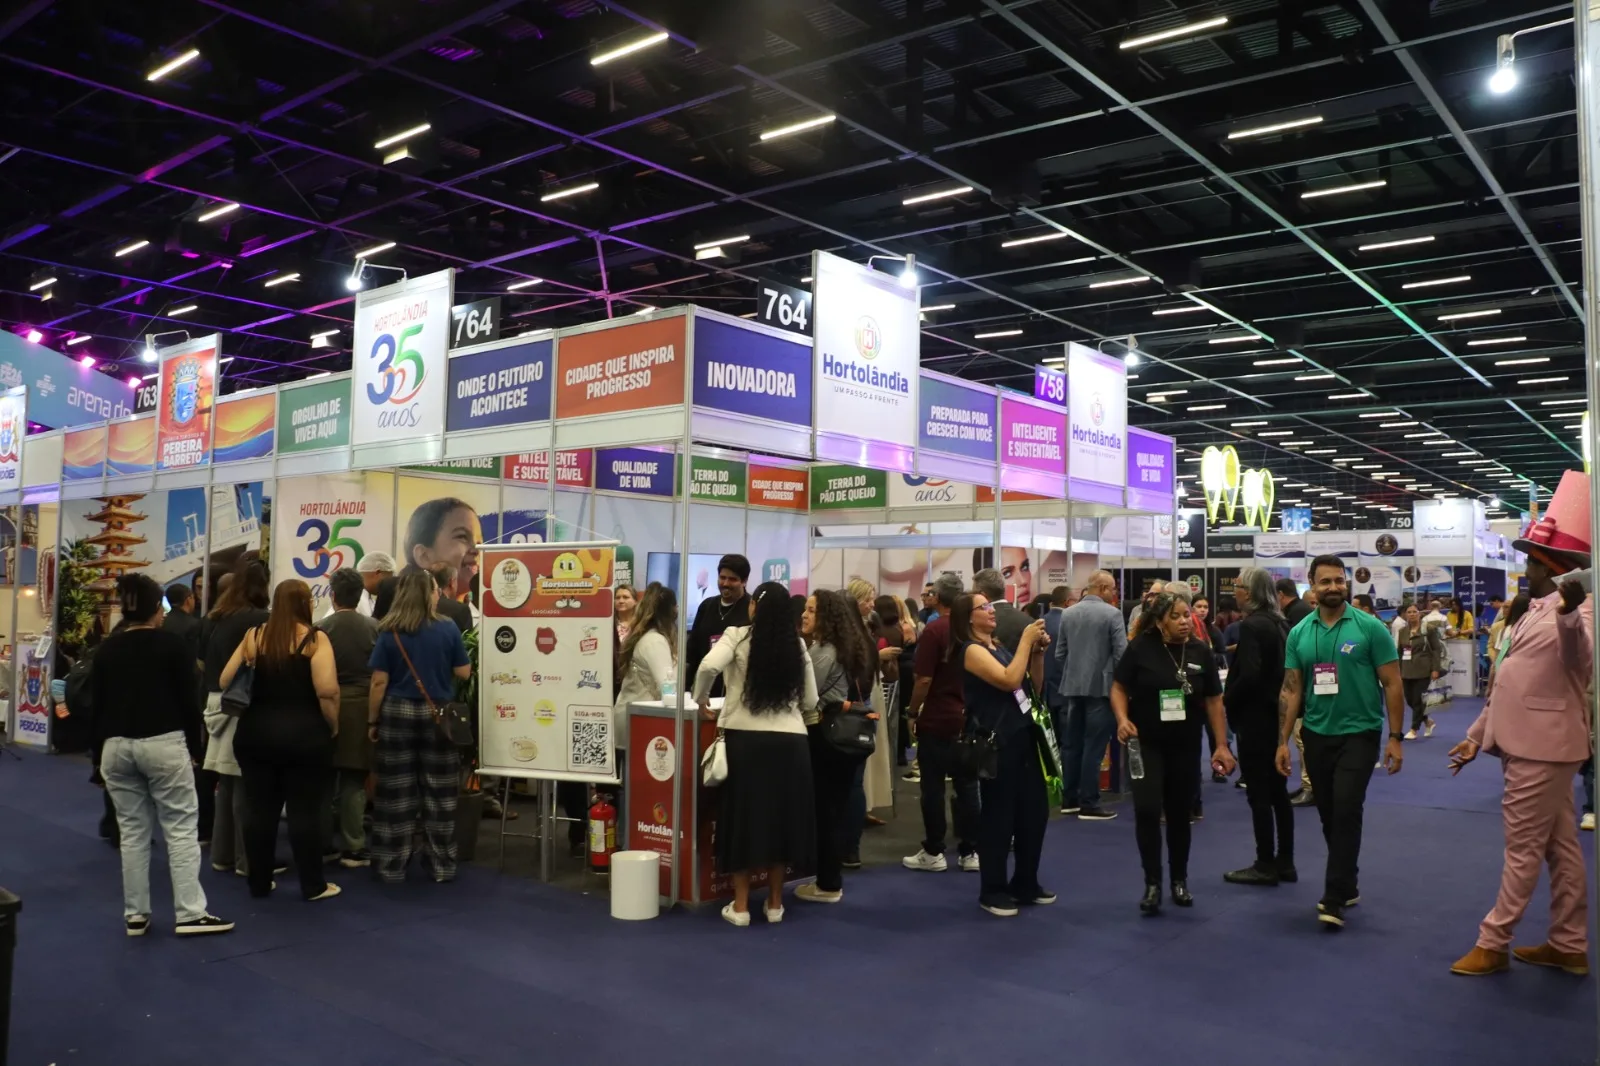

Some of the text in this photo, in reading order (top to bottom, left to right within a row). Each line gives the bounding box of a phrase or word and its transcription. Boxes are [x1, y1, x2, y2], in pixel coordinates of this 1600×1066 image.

[373, 299, 429, 333] HORTOLÂNDIA
[763, 287, 807, 330] 764
[454, 306, 493, 342] 764
[366, 322, 426, 406] 35
[565, 344, 675, 387] CIDADE QUE INSPIRA
[822, 353, 909, 394] Hortolândia
[457, 360, 544, 400] ONDE O FUTURO
[586, 370, 651, 400] PROGRESSO
[707, 361, 796, 398] INOVADORA
[1038, 372, 1064, 402] 758
[67, 386, 111, 418] arena
[137, 384, 158, 409] 763
[470, 387, 528, 418] ACONTECE
[834, 385, 845, 394] UM
[845, 388, 868, 400] PASSO
[874, 394, 899, 407] FRENTE
[292, 397, 341, 426] ORGULHO DE
[377, 402, 422, 429] anos
[931, 405, 989, 427] PREPARADA PARA
[294, 418, 337, 444] VIVER AQUI
[926, 421, 993, 442] CRESCER COM VOCÊ
[1012, 422, 1057, 443] INTELIGENTE
[1072, 423, 1121, 450] Hortolândia
[163, 438, 203, 455] PEREIRA
[1008, 443, 1014, 457] E
[1014, 440, 1062, 461] SUSTENTÁVEL
[163, 451, 203, 468] BARRETO
[519, 451, 578, 466] INTELIENTE
[612, 460, 658, 475] QUALIDADE
[1136, 452, 1165, 468] QUALIDADE
[513, 464, 583, 481] E SUSTETÁVEL
[619, 474, 651, 489] DE VIDA
[693, 468, 729, 482] TERRA DO
[828, 475, 867, 489] TERRA DO
[1141, 468, 1149, 482] DE
[690, 480, 737, 497] ÃO DE QUEIJO
[752, 479, 804, 493] CIDADE QUE INSPIRA
[762, 490, 794, 501] PROGRESSO
[820, 486, 876, 504] PÃO DE QUEIJO
[914, 484, 957, 503] anos
[300, 499, 366, 516] HORTOLÂNDIA
[1390, 517, 1411, 529] 750
[292, 518, 365, 578] 35
[580, 669, 598, 682] Fiel
[19, 719, 47, 734] PERDÕES
[637, 820, 683, 839] Hortolâna
